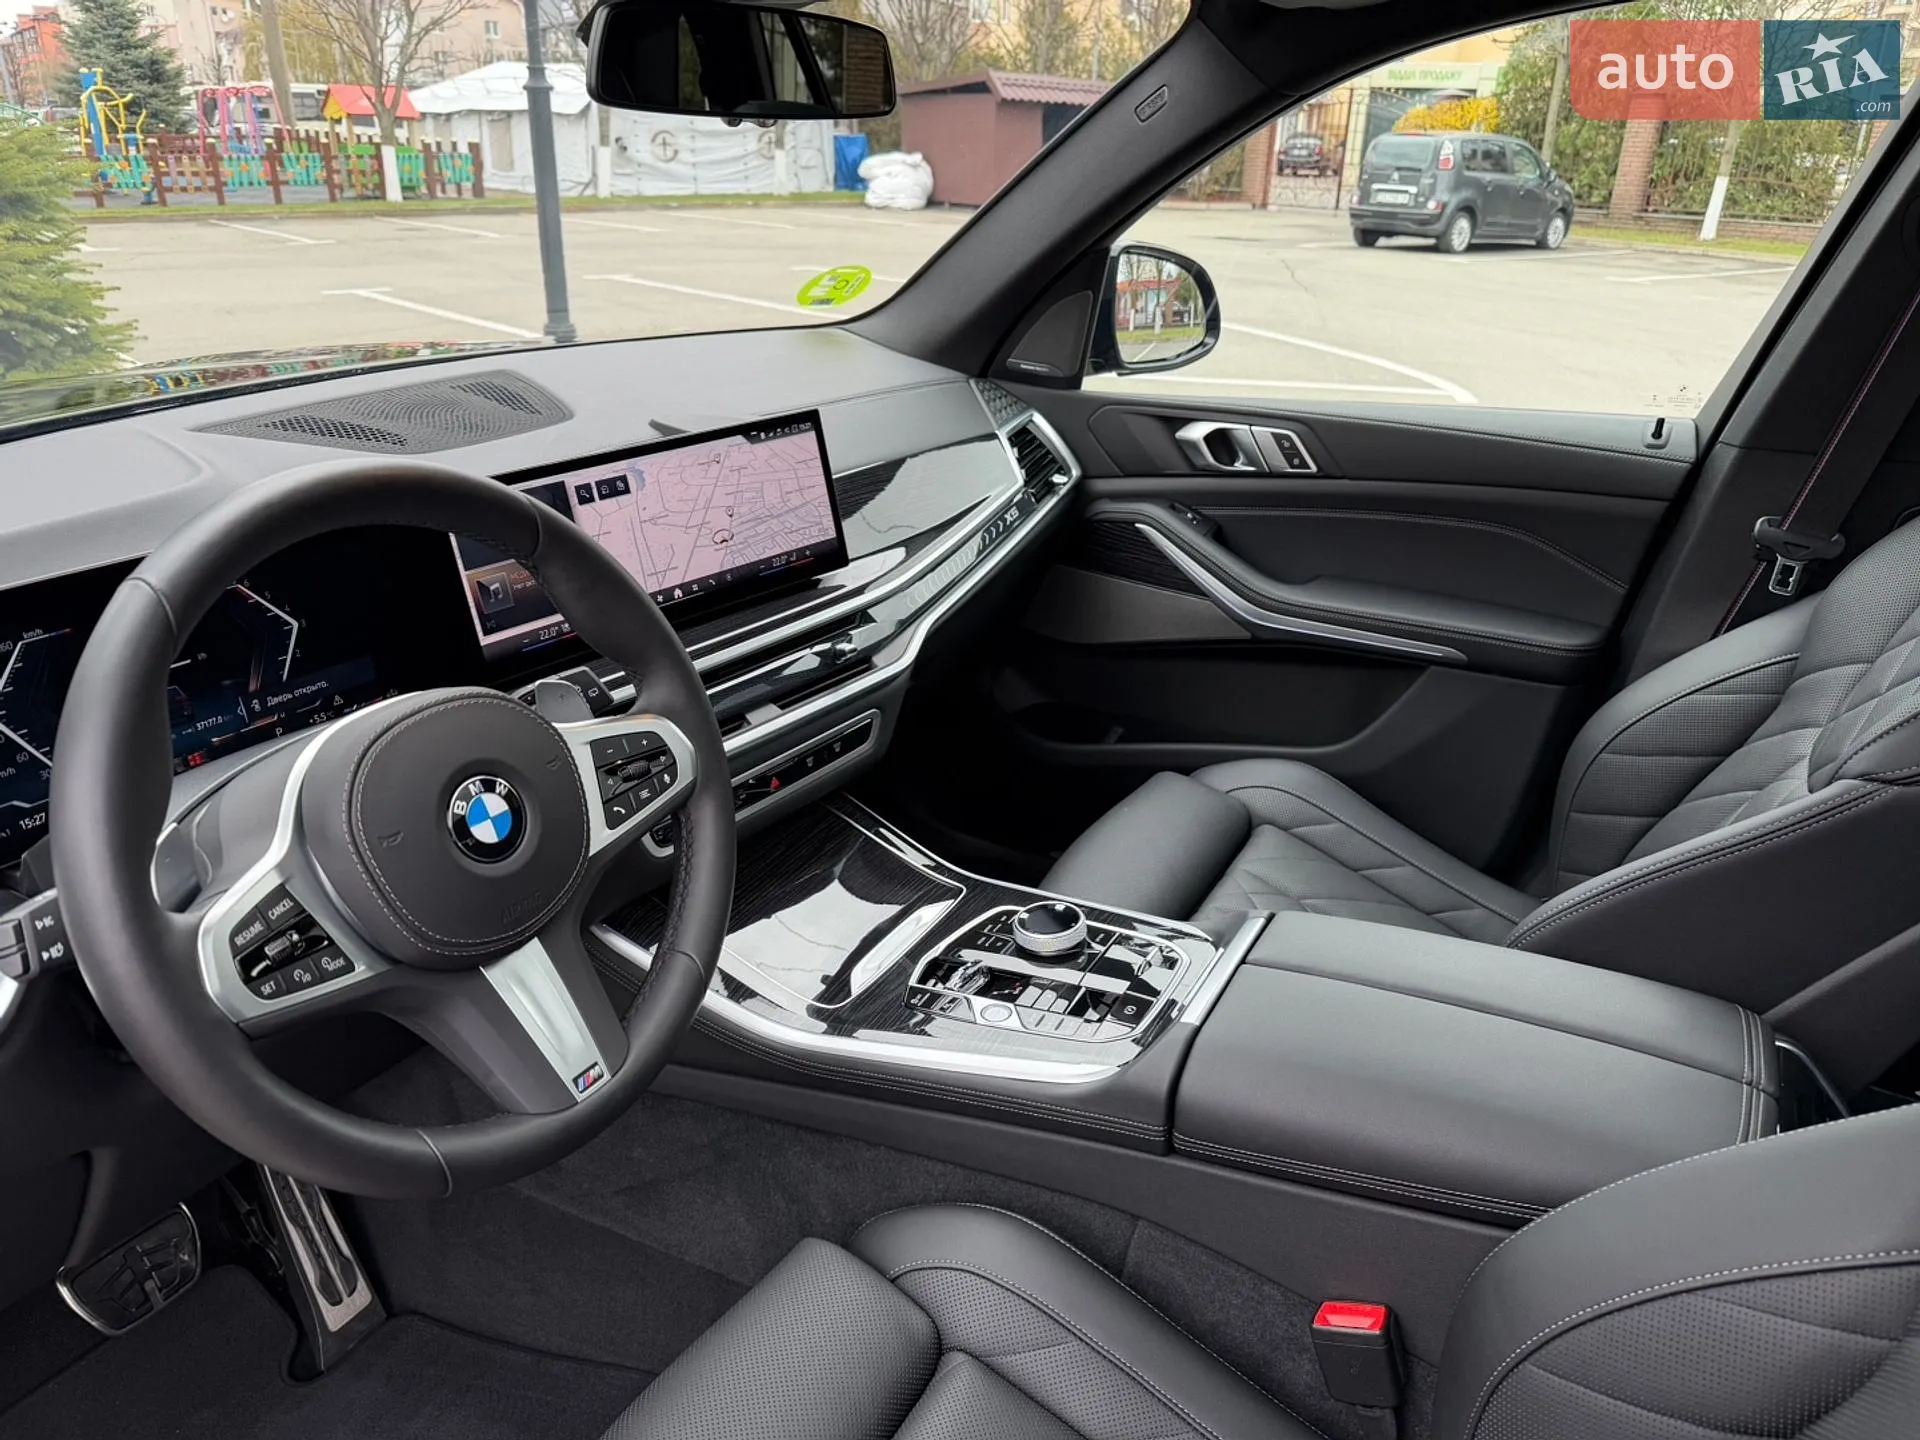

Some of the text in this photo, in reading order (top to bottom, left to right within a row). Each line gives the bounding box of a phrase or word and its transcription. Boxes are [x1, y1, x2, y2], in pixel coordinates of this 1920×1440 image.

[22, 628, 43, 639] km/h
[16, 752, 29, 763] 60
[453, 780, 509, 816] BMW
[19, 812, 46, 830] 15:27
[268, 898, 295, 920] CANCEL
[234, 920, 264, 946] RESUME
[260, 981, 276, 996] SET
